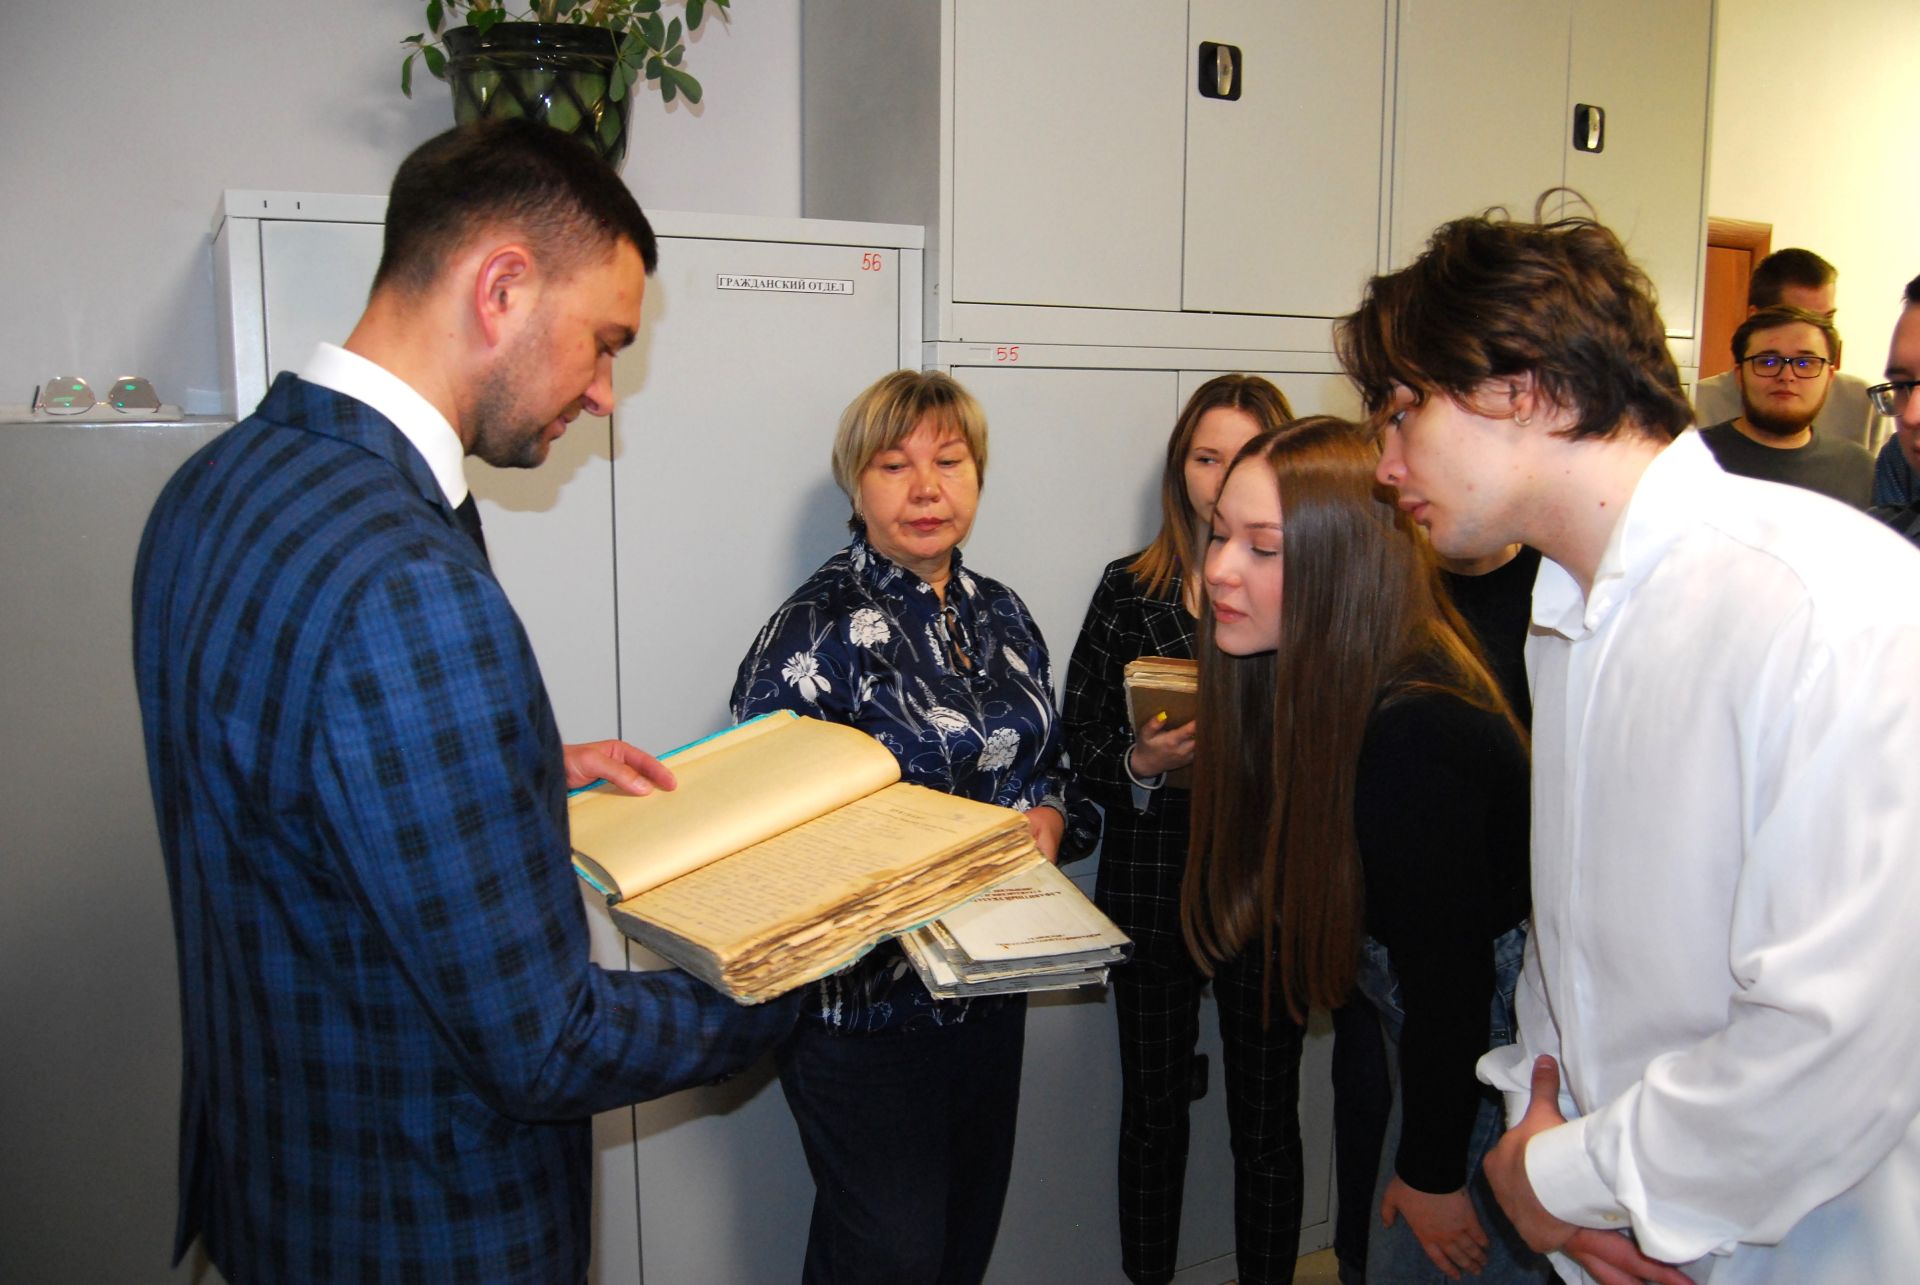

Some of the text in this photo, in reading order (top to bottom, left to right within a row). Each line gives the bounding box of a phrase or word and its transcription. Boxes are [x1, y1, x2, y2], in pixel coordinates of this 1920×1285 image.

[861, 252, 882, 272] 56
[719, 276, 846, 292] ГРАЖДАНСКИЙ ОТДЕЛ
[997, 346, 1020, 361] 55
